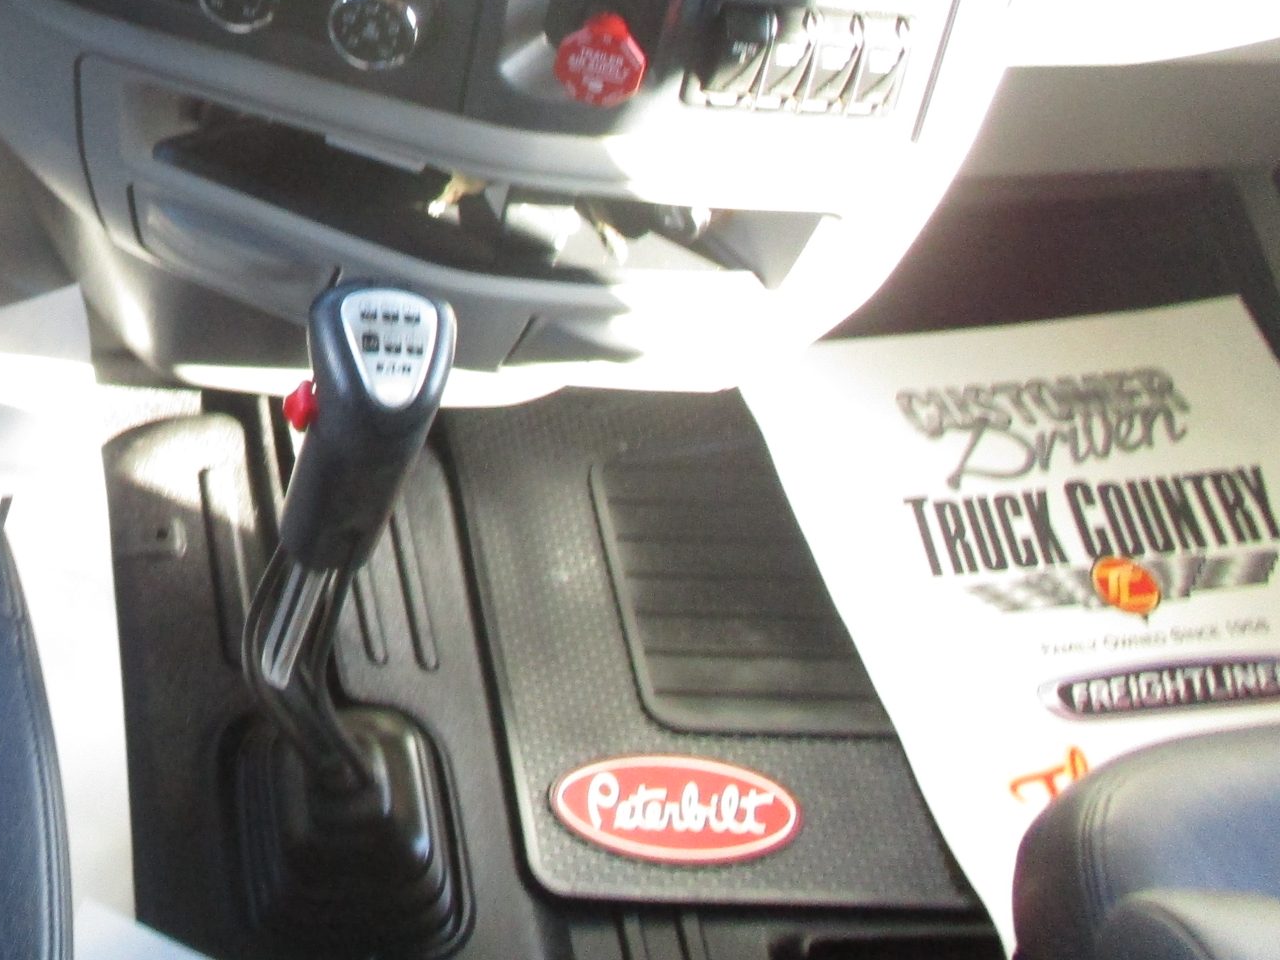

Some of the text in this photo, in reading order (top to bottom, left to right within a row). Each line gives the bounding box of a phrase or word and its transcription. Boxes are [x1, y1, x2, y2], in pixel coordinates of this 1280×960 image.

[903, 464, 1280, 577] TRUCK COUNTRY
[1072, 660, 1280, 714] FREIGHTLINE
[586, 770, 776, 835] Peterbilt
